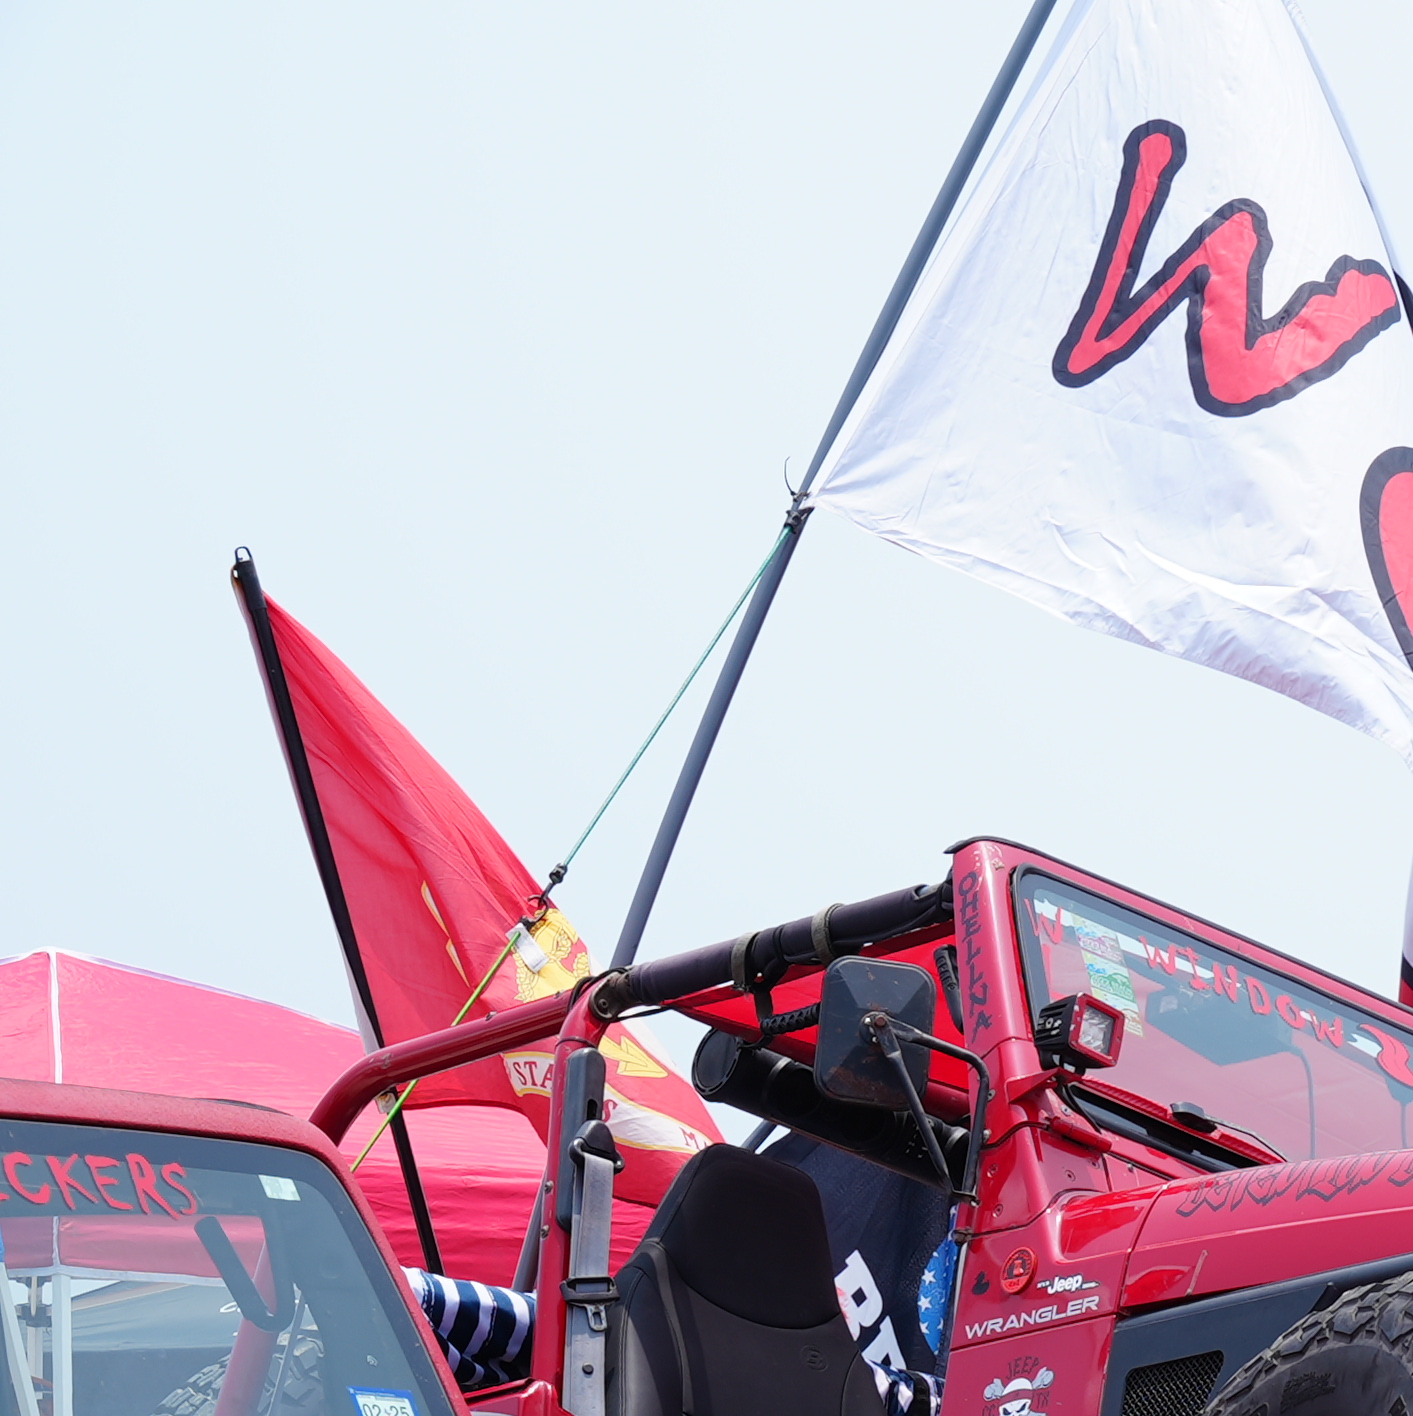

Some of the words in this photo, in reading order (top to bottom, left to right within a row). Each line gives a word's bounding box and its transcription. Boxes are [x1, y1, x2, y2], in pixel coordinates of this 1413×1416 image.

[1138, 935, 1344, 1048] WINDOW
[0, 1151, 198, 1221] CKERS
[1047, 1275, 1083, 1295] Jeep
[965, 1296, 1100, 1340] WRANGLER
[1005, 1356, 1041, 1380] JEEP
